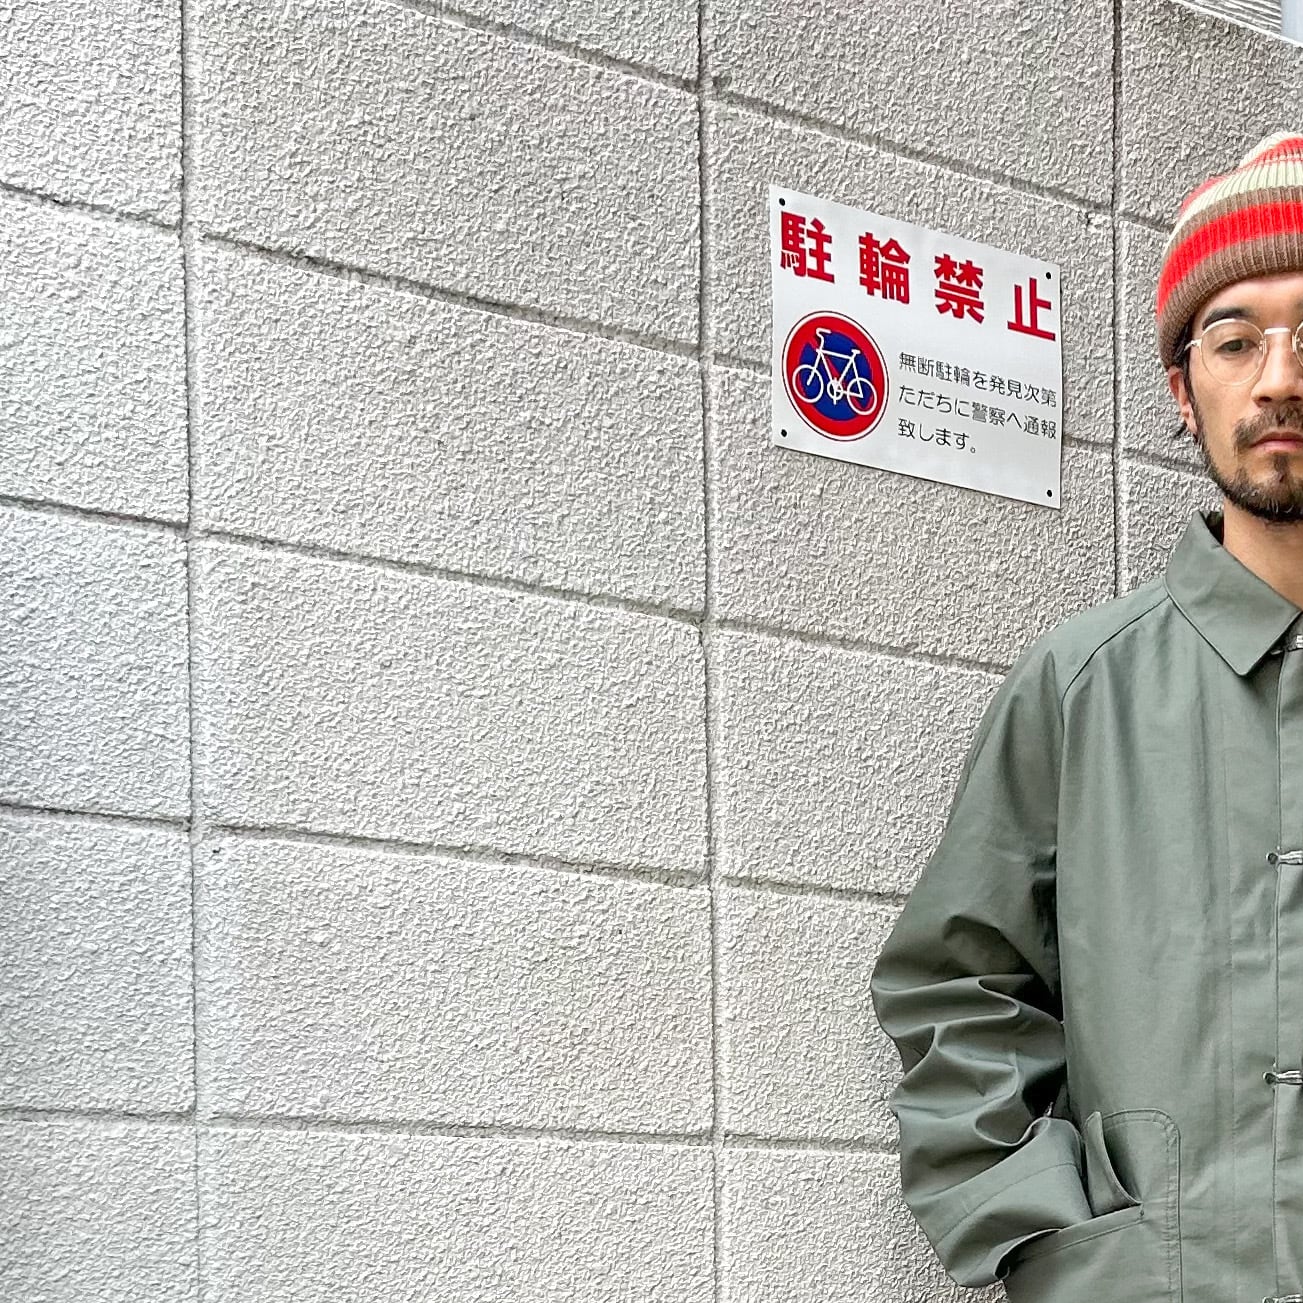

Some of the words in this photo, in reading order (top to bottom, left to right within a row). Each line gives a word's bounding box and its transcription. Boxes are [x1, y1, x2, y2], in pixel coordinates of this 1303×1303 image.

[780, 211, 1056, 341] 駐輪禁止
[899, 352, 1057, 408] 無断駐輪を発見次第
[898, 417, 976, 454] 致します。
[899, 384, 1057, 440] ただちに警察へ通報
